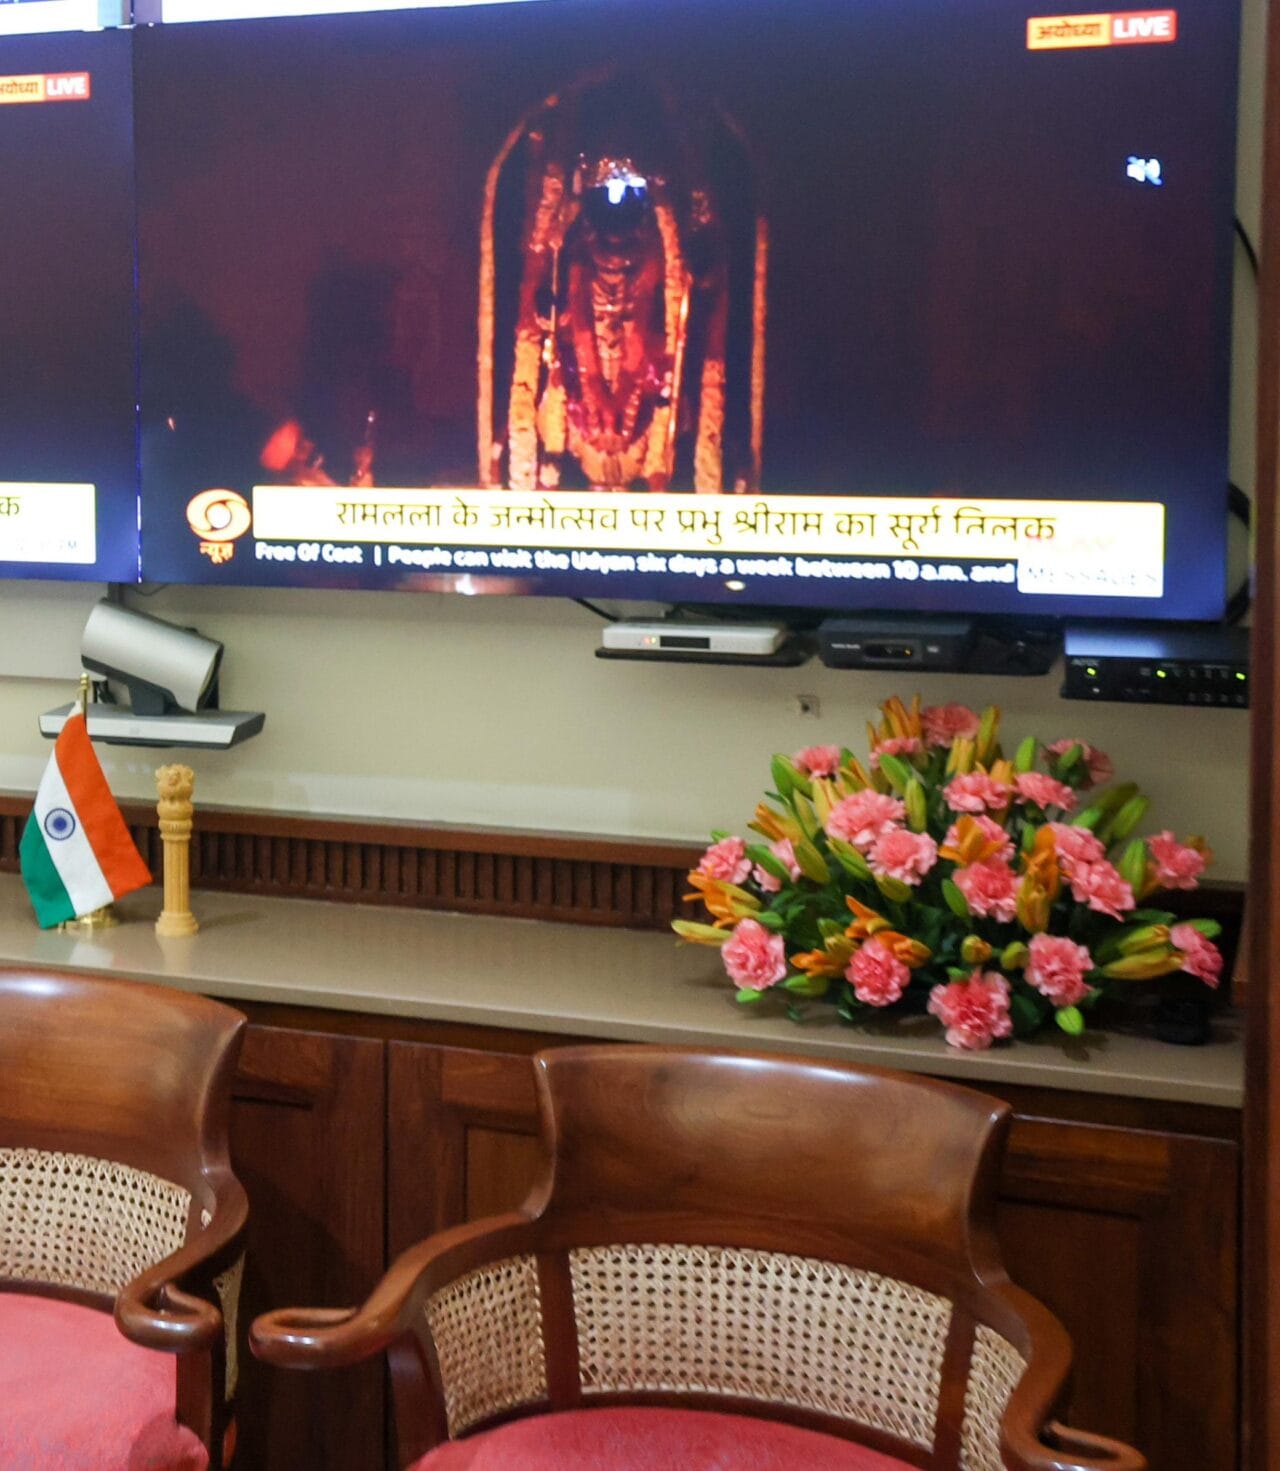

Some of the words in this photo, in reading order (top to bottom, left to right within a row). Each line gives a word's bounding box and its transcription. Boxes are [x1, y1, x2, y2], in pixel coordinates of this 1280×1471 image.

[1113, 16, 1171, 39] LIVE
[46, 76, 87, 96] LIVE
[336, 502, 443, 528] रामलला
[452, 496, 480, 528] के
[489, 498, 619, 531] जन्मोत्सव
[630, 509, 666, 532] पर
[677, 509, 724, 545] प्रभु
[733, 502, 824, 536] श्रीराम
[833, 512, 878, 537] का
[888, 505, 942, 550] सूर्य
[953, 505, 1057, 541] तिलक
[255, 542, 296, 561] Free
[298, 543, 320, 562] Of
[322, 544, 363, 563] Cost
[389, 546, 453, 568] People
[454, 551, 489, 567] can
[490, 549, 533, 569] visit
[534, 550, 570, 570] the
[572, 551, 636, 575] Udyan
[637, 553, 667, 573] six
[669, 554, 718, 577] days
[720, 558, 735, 574] a
[737, 557, 794, 577] week
[796, 557, 891, 580] between
[892, 560, 919, 580] 10
[921, 564, 969, 582] a.m.
[970, 564, 1016, 583] and
